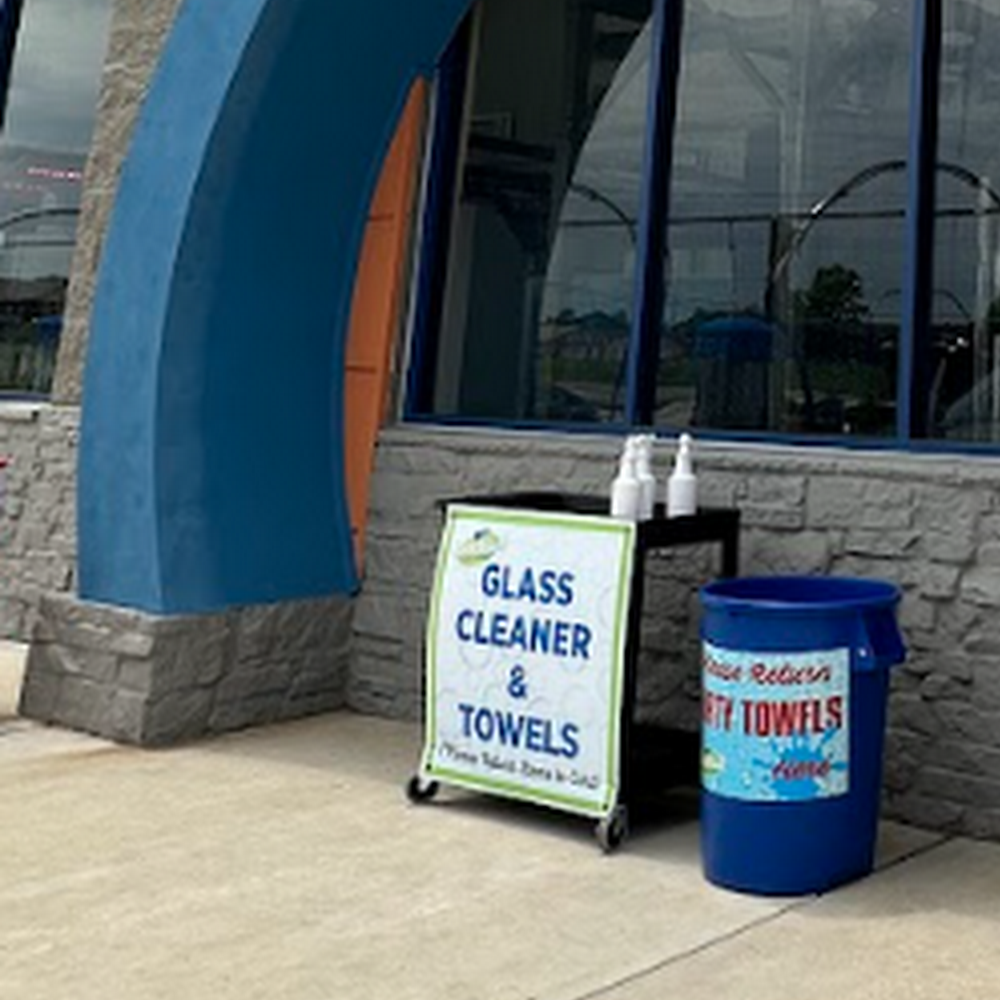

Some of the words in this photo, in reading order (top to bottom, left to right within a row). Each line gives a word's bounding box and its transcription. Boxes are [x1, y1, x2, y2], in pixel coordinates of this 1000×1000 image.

[481, 562, 575, 607] GLASS
[456, 608, 593, 660] CLEANER
[507, 664, 527, 699] &
[457, 703, 580, 759] TOWELS
[741, 695, 843, 737] TOWELS
